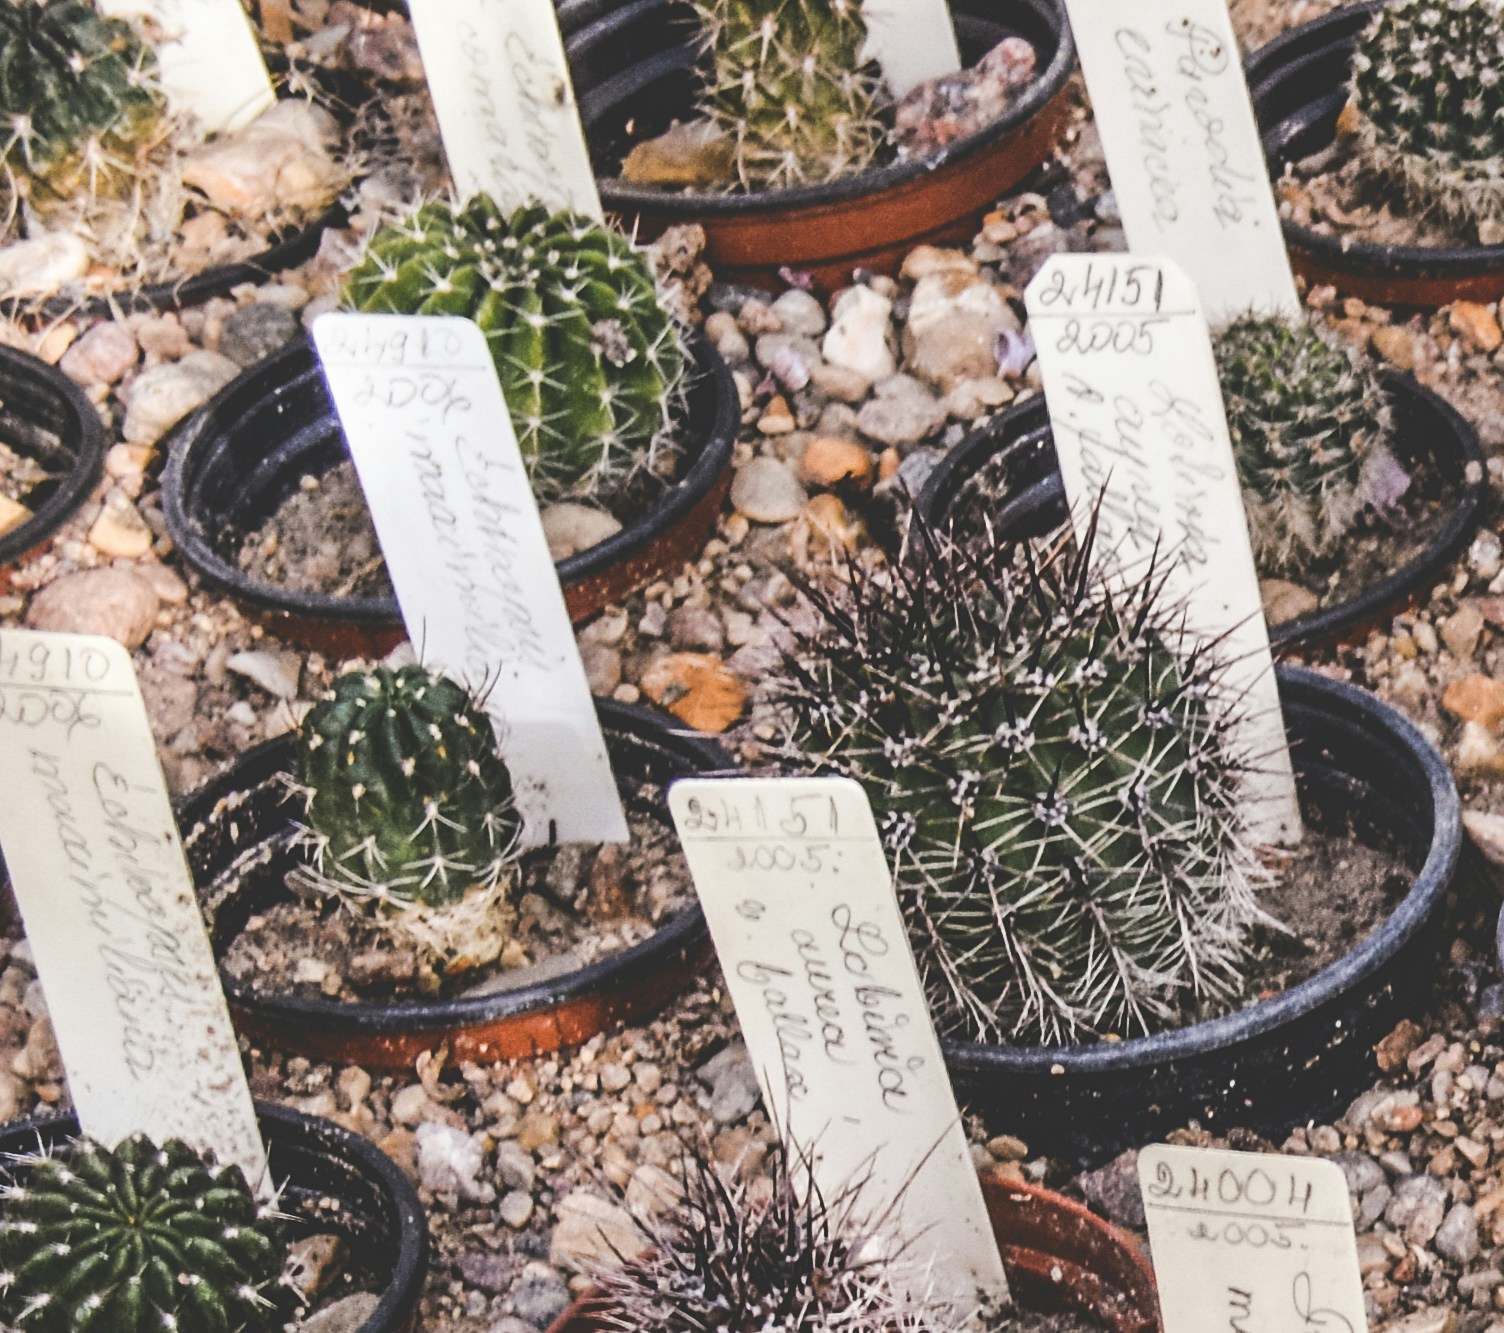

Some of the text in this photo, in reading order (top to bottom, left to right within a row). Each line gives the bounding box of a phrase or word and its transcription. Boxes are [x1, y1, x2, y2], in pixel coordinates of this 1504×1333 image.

[1166, 15, 1261, 230] Parodia
[1040, 264, 1167, 315] 24151
[1056, 316, 1174, 358] 2005
[684, 797, 841, 838] 24151
[734, 958, 813, 1102] fallax
[790, 930, 857, 1067] aurea
[832, 903, 927, 1116] Lobivia
[1146, 1165, 1313, 1214] 24004
